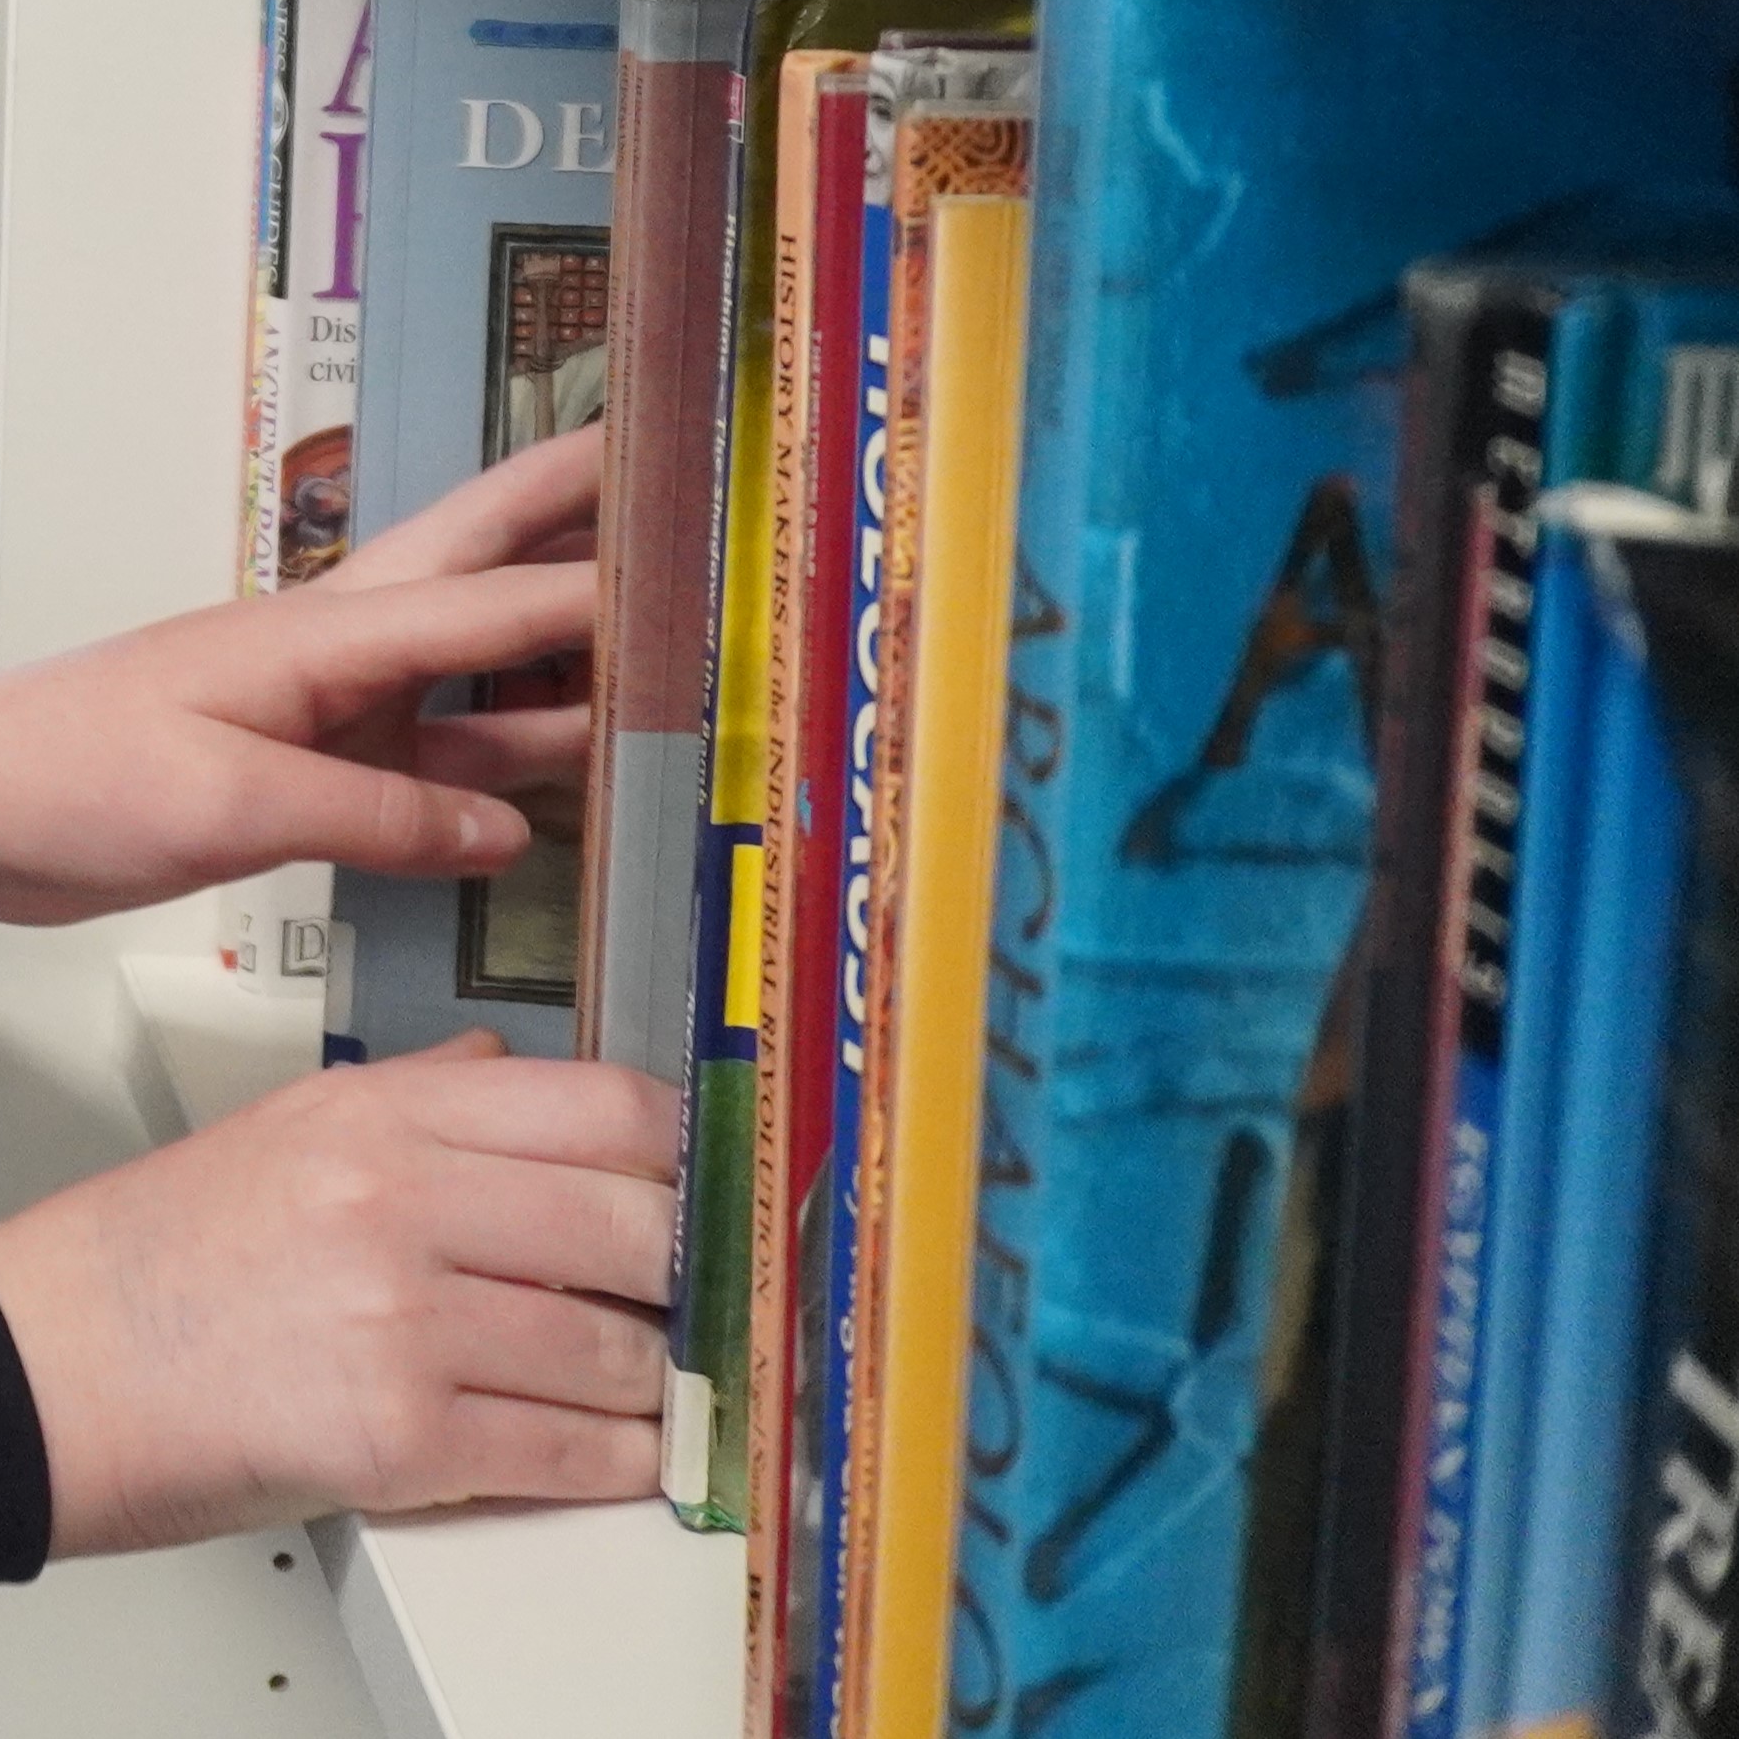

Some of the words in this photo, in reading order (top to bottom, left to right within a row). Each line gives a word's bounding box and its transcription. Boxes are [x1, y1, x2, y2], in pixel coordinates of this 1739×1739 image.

[718, 212, 737, 373] Hiroshima
[776, 234, 797, 428] HISTORY
[713, 413, 727, 471] The
[708, 481, 724, 607] Shadow
[773, 443, 792, 624] MAKERS
[702, 657, 715, 708] the
[706, 615, 717, 651] of
[769, 677, 785, 723] the
[771, 633, 786, 669] of
[763, 735, 784, 996] INDUSTRIAL
[677, 989, 698, 1154] RICHARD
[757, 1011, 777, 1303] REVOLUTION
